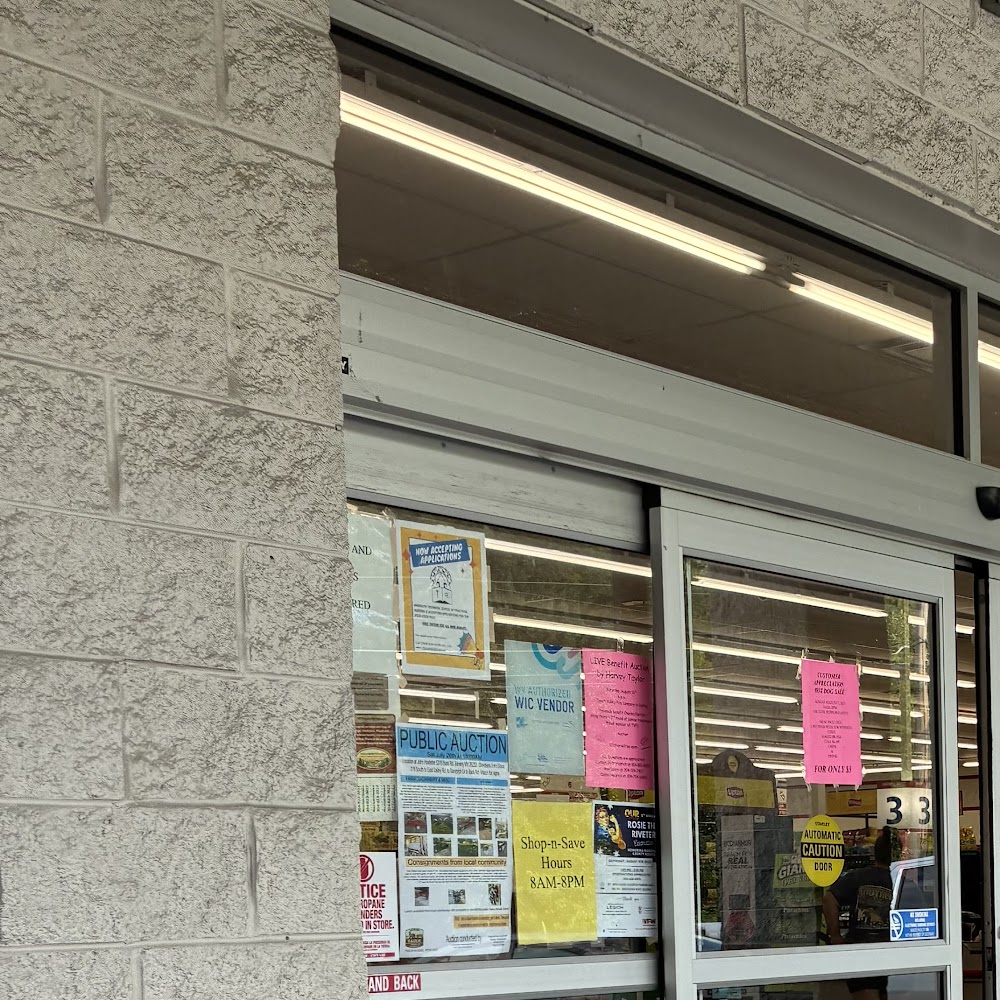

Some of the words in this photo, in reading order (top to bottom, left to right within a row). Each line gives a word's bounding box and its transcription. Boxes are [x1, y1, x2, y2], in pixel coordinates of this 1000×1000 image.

[415, 547, 429, 556] NOW
[430, 543, 463, 554] ACCEPTING
[420, 552, 462, 565] APPLICATIONS
[590, 657, 605, 666] LIVE
[606, 658, 628, 669] Benefit
[596, 669, 604, 679] by
[605, 671, 626, 682] Harvey
[527, 686, 571, 699] AUTHORIZED
[514, 696, 534, 710] WIC
[537, 698, 575, 713] VENDOR
[400, 729, 448, 751] PUBLIC
[450, 732, 507, 754] AUCTION
[814, 765, 827, 774] FOR
[827, 765, 846, 774] ONLY
[886, 796, 903, 825] 3
[918, 797, 931, 825] 3
[627, 820, 646, 829] ROSIE
[647, 821, 656, 830] TH
[631, 830, 656, 838] RIVETER
[804, 829, 842, 841] AUTOMATIC
[520, 836, 586, 853] Shop-n-Save
[802, 843, 843, 858] CAUTION
[407, 859, 449, 867] Consignments
[478, 859, 507, 867] community
[540, 856, 573, 870] Hours
[727, 857, 749, 865] REAL
[814, 862, 833, 872] DOOR
[530, 875, 585, 890] 8AM-8PM
[365, 921, 372, 930] IN
[373, 919, 395, 930] STORE.
[367, 975, 389, 992] AND
[393, 974, 420, 991] BACK
